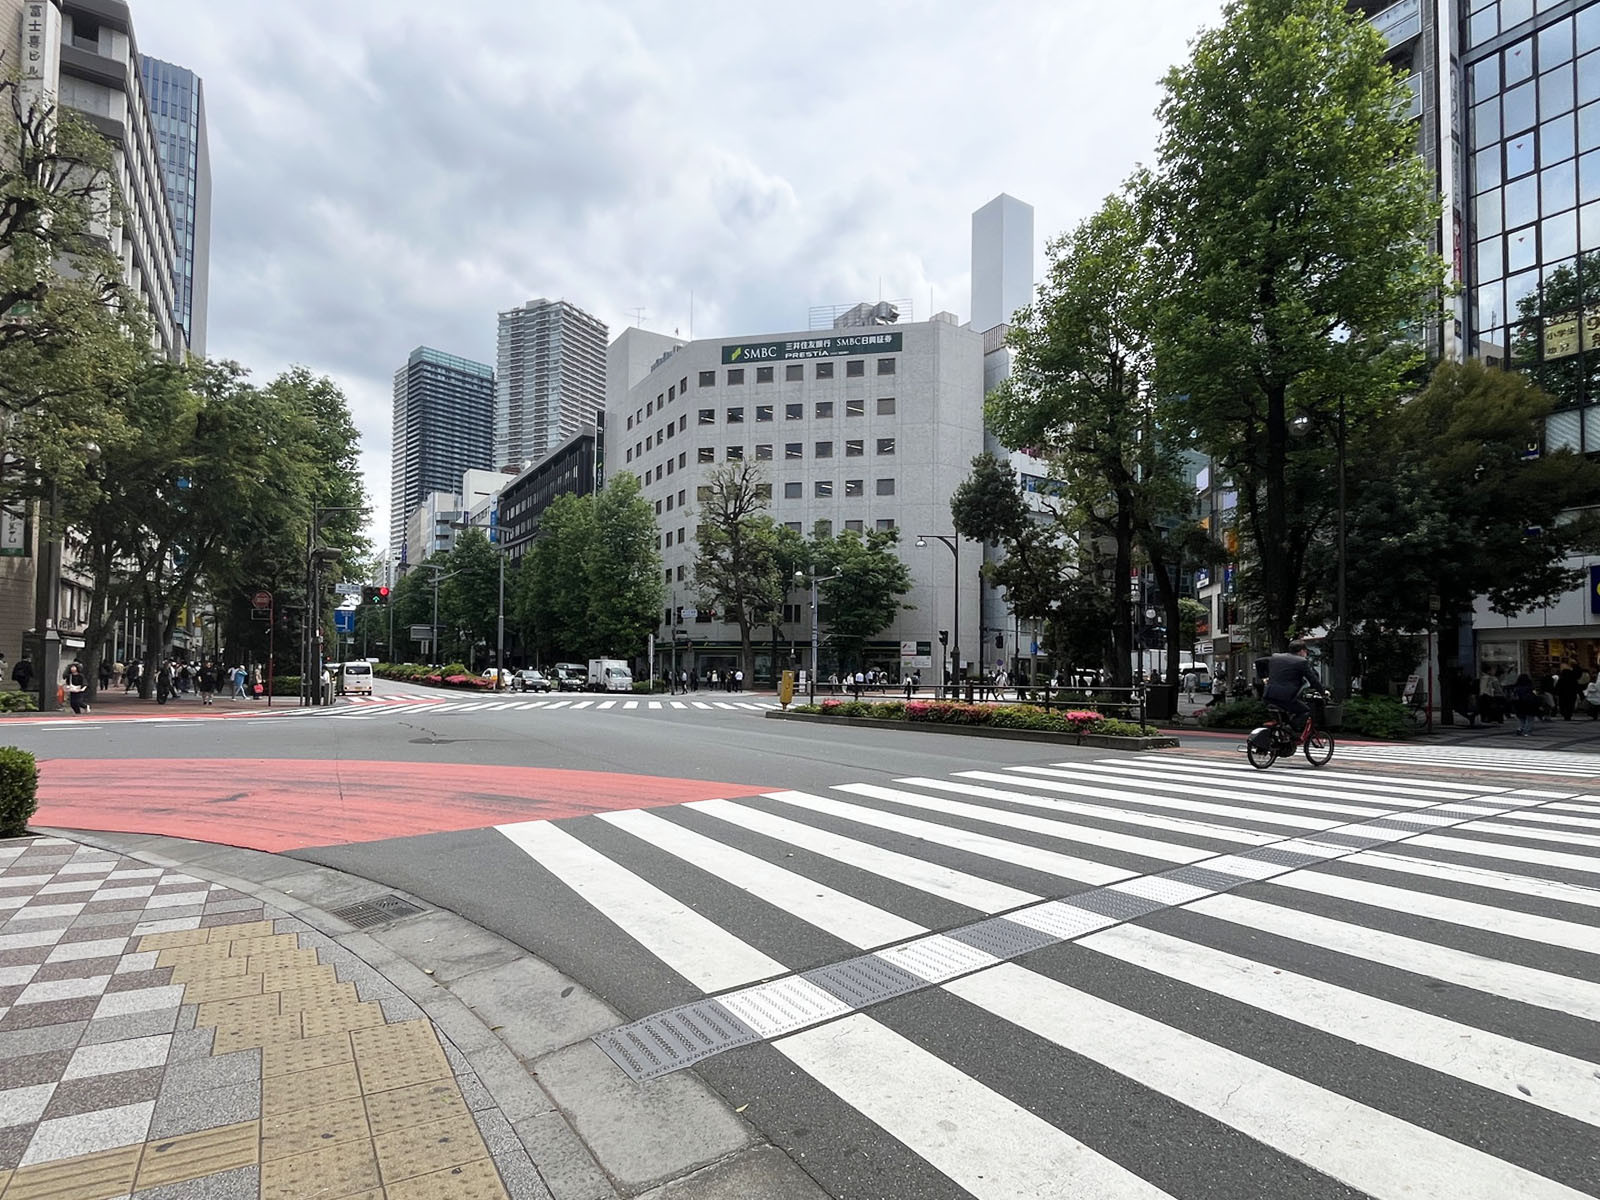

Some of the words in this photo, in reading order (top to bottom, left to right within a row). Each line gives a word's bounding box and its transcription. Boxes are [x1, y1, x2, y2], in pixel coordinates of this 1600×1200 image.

[785, 339, 831, 350] 三井住友銀行
[743, 346, 777, 359] SMBC
[785, 350, 829, 359] PRESTIA
